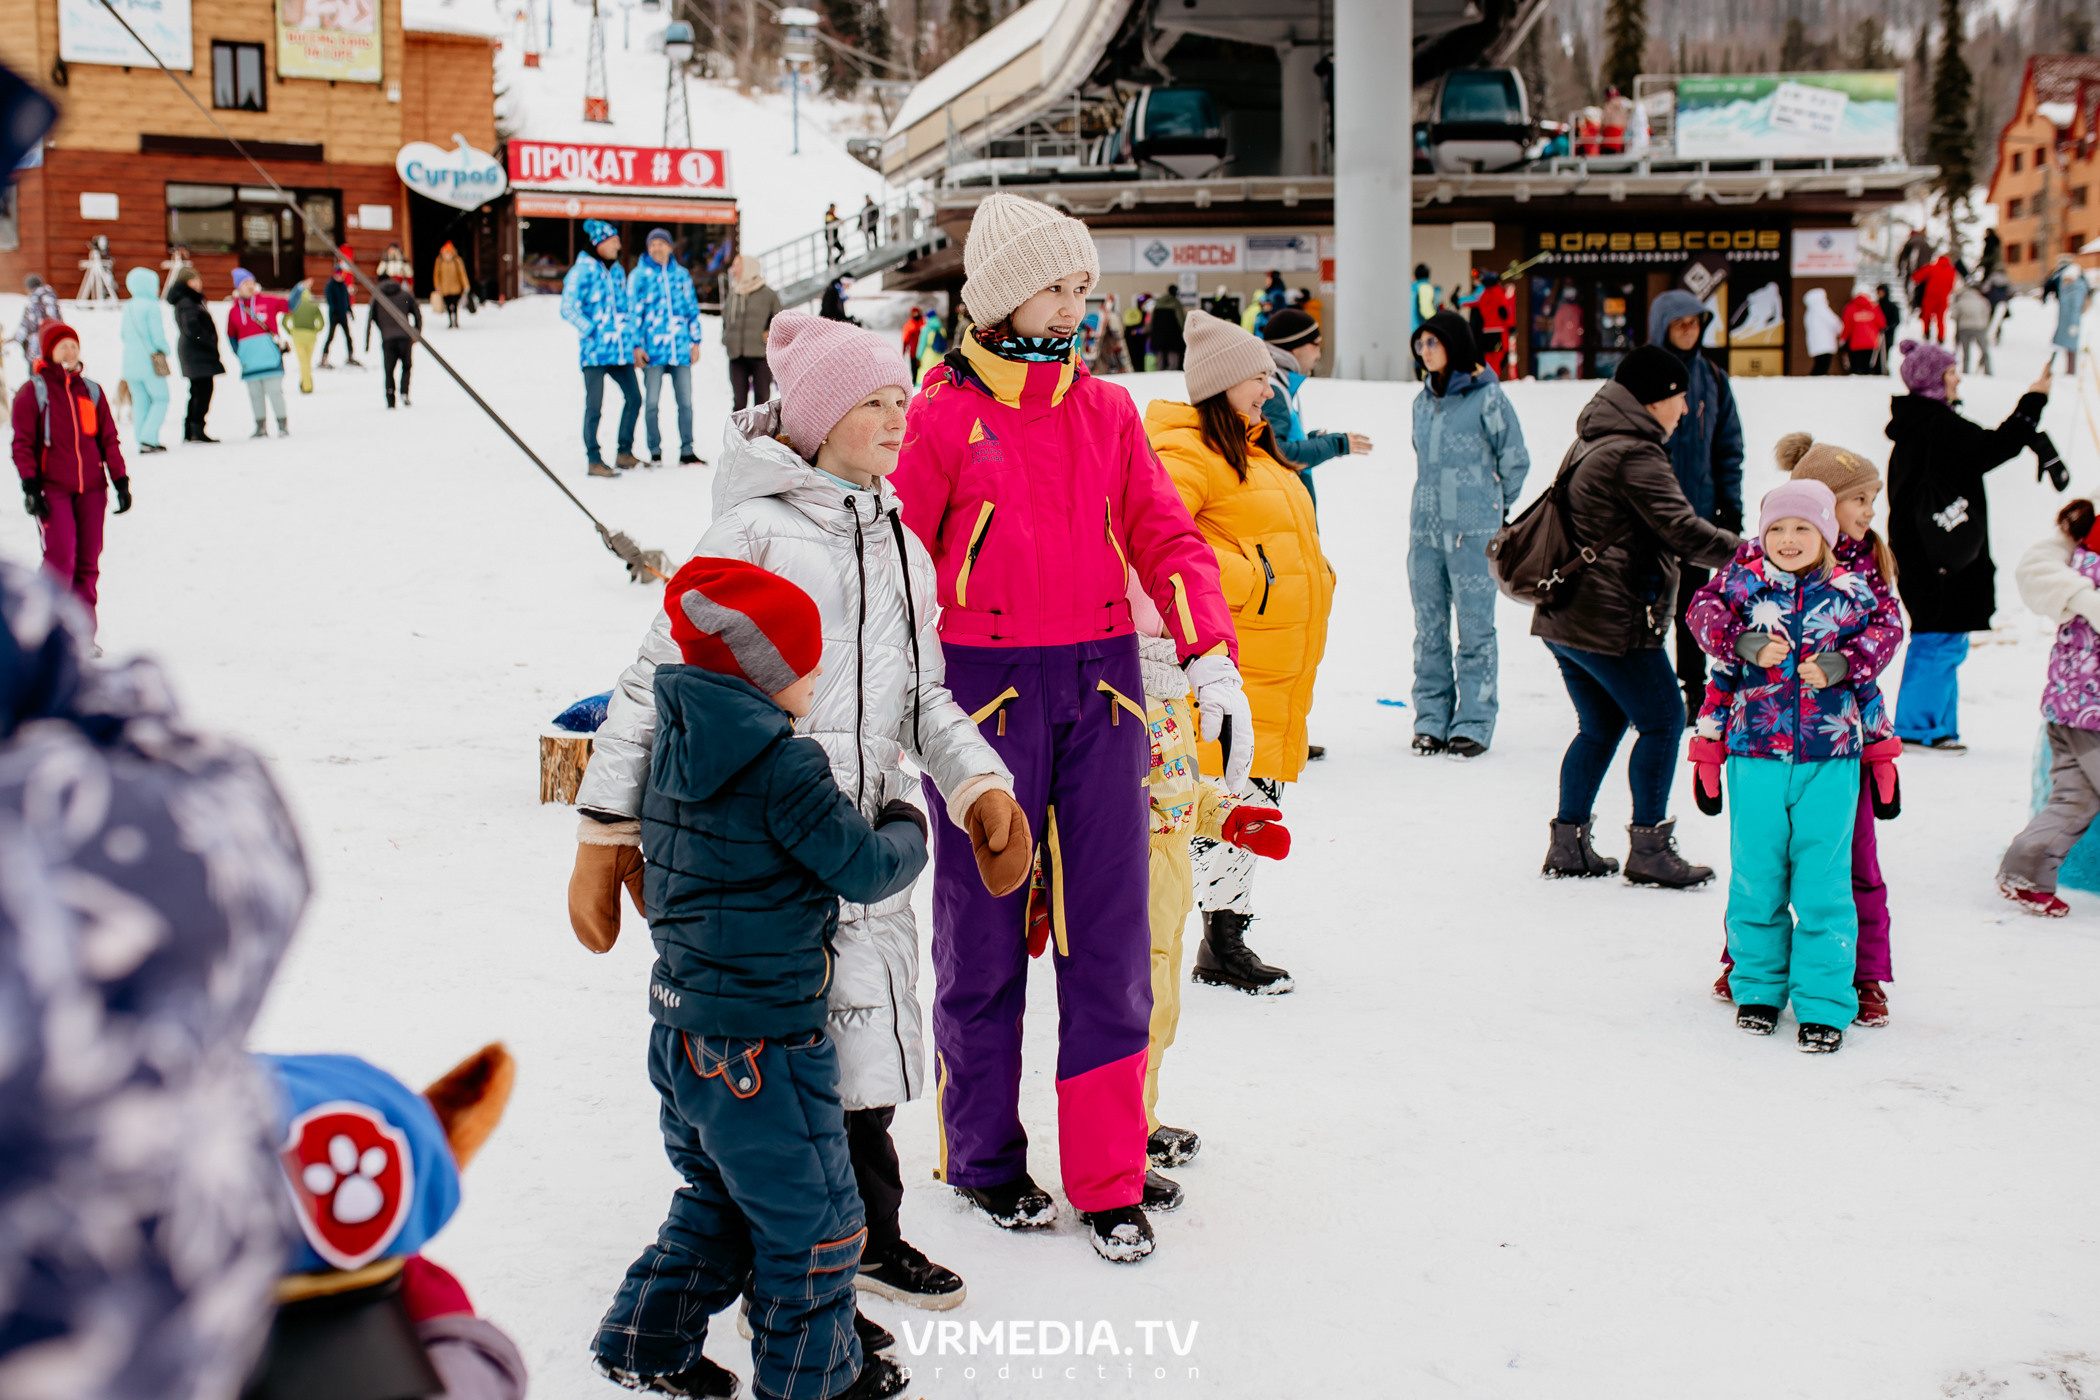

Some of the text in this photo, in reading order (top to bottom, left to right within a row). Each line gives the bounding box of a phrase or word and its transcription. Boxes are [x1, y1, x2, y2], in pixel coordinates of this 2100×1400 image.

[405, 161, 498, 188] Сугроб
[520, 146, 637, 181] ПРОКАТ
[652, 152, 671, 183] #
[1173, 244, 1236, 266] КАССЫ
[971, 449, 1003, 458] ENDLESS
[972, 456, 1004, 465] EXPLORE
